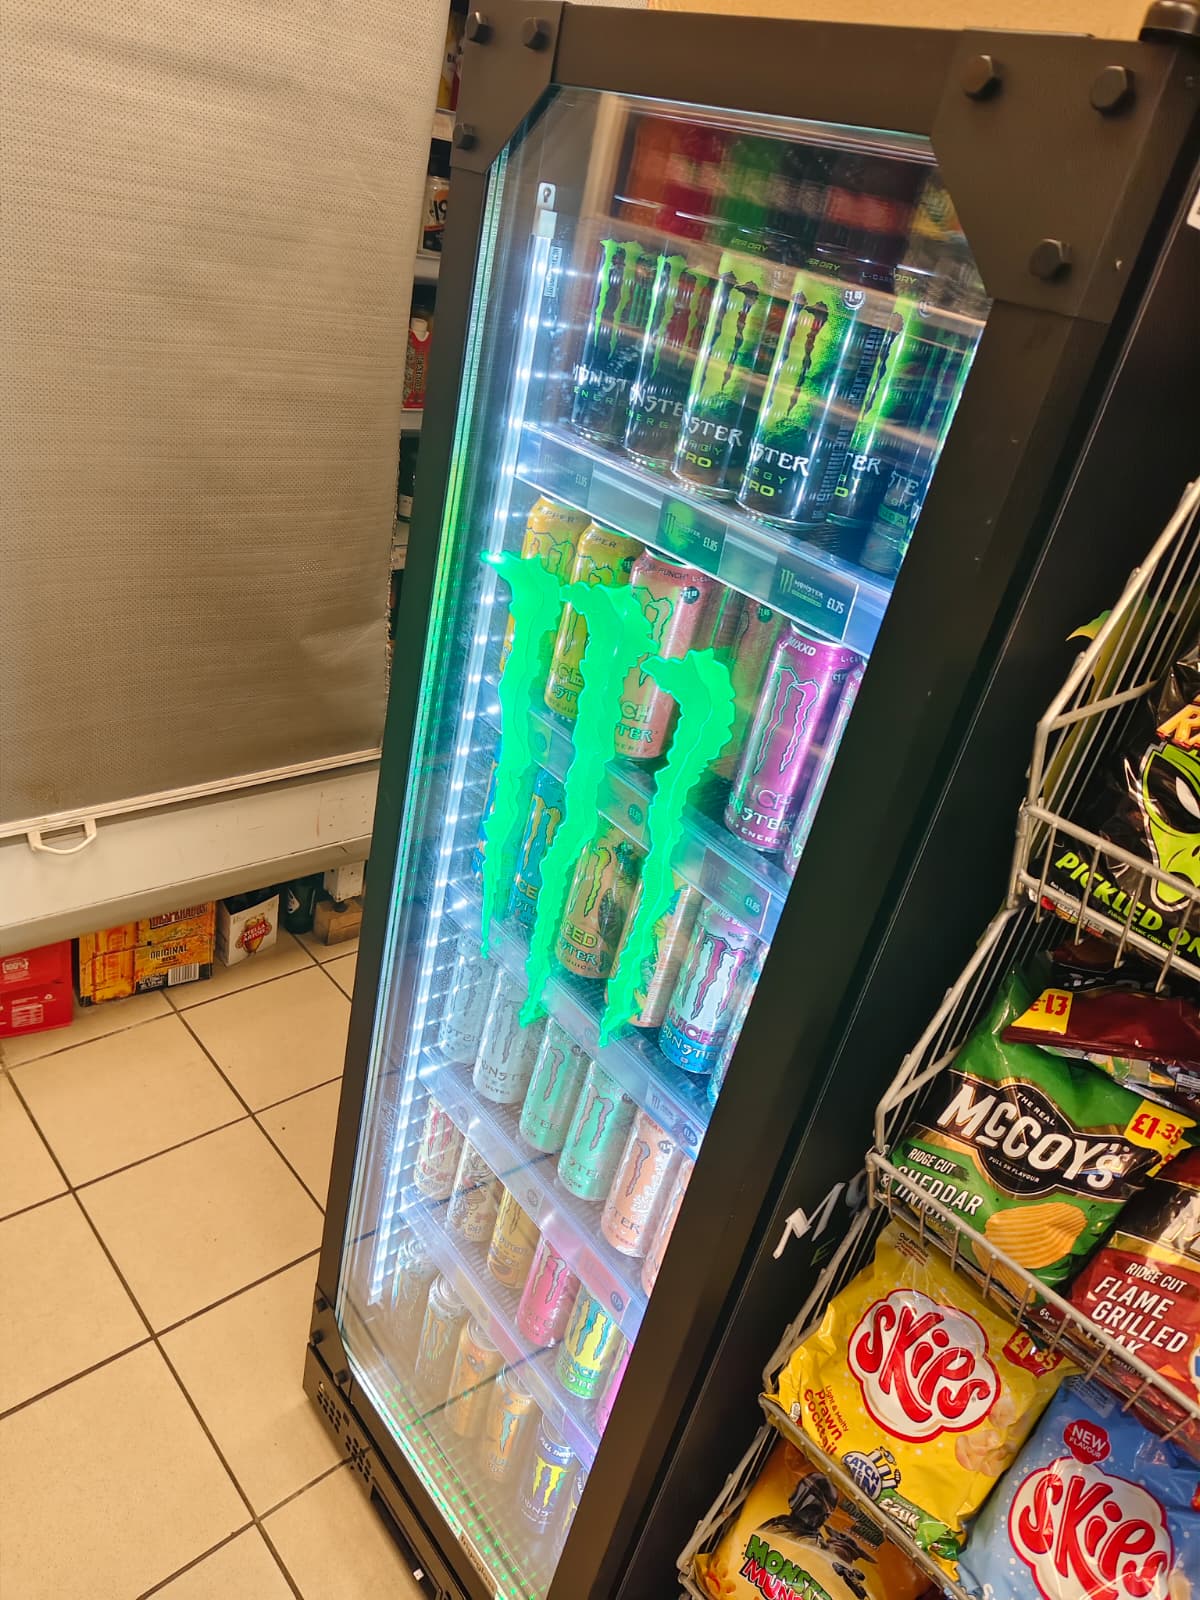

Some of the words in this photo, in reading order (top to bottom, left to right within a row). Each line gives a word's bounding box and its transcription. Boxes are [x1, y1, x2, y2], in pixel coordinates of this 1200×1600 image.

[826, 597, 845, 615] £1.75
[1055, 852, 1163, 931] PICKLED
[150, 944, 188, 960] ORIGINAL
[1016, 1091, 1033, 1109] THE
[1033, 1105, 1056, 1127] REAL
[1131, 1113, 1184, 1145] £1.35
[907, 1148, 937, 1168] RIDGE
[934, 1159, 957, 1175] CUT
[987, 1156, 1003, 1171] FULL
[1012, 1167, 1041, 1185] FLAVOUR
[897, 1165, 984, 1217] CHEDDAR
[1125, 1262, 1163, 1287] RIDGE
[1160, 1274, 1187, 1294] CUT
[1094, 1276, 1175, 1320] FLAME
[1091, 1300, 1189, 1353] GRILLED
[804, 1389, 838, 1456] Cocktail
[815, 1390, 843, 1441] Prawn
[1069, 1437, 1102, 1459] FLAVOUR
[1072, 1424, 1106, 1451] NEW
[844, 1454, 881, 1487] CATCH
